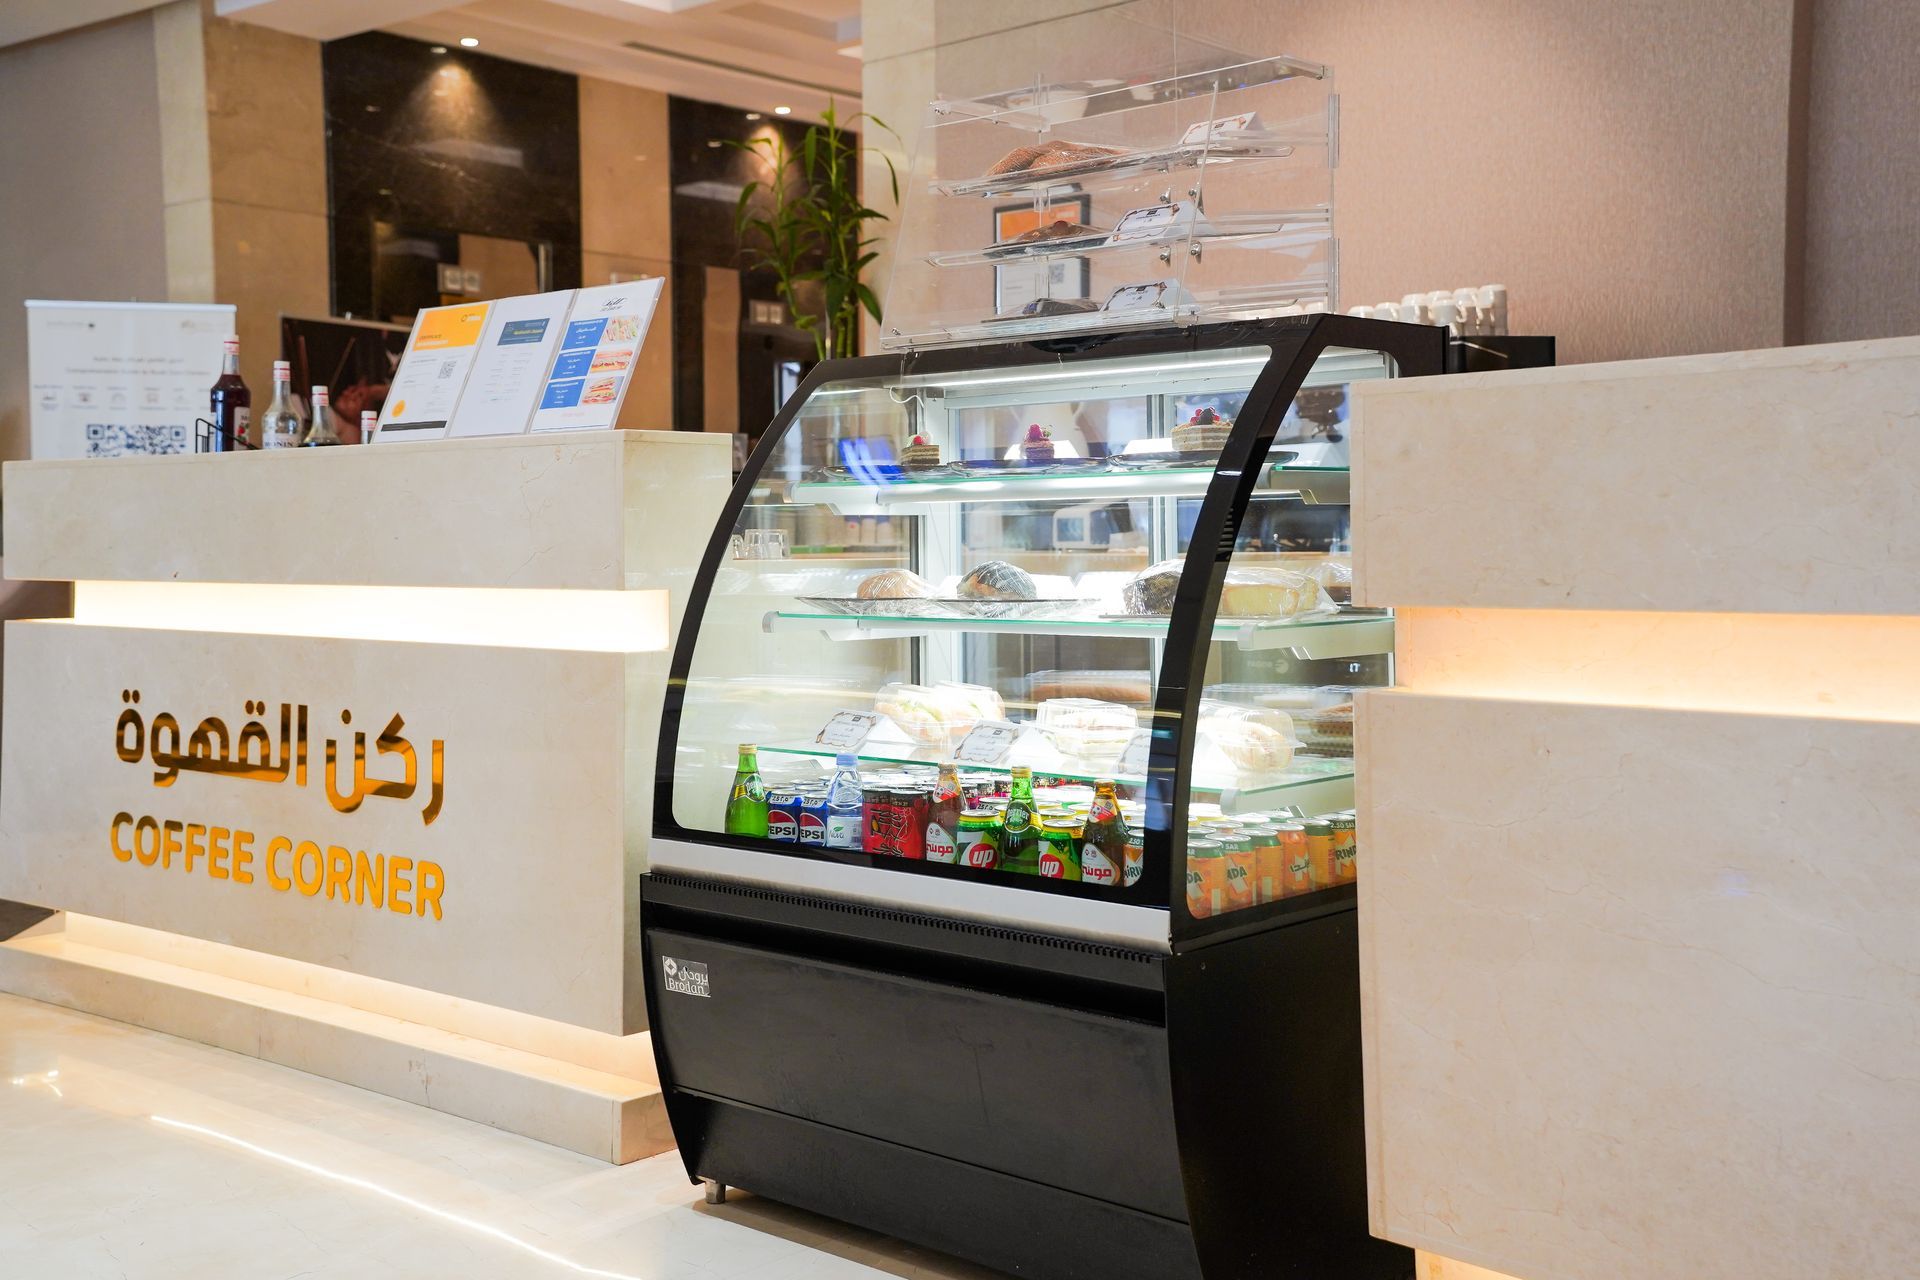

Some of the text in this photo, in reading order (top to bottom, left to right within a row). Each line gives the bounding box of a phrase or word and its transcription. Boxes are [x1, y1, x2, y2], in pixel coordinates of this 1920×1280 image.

[115, 688, 445, 826] ركن القهوة
[768, 826, 796, 836] EPSI
[800, 829, 824, 840] EPSI
[110, 811, 445, 921] COFFEE CORNER
[668, 977, 705, 995] Brodan
